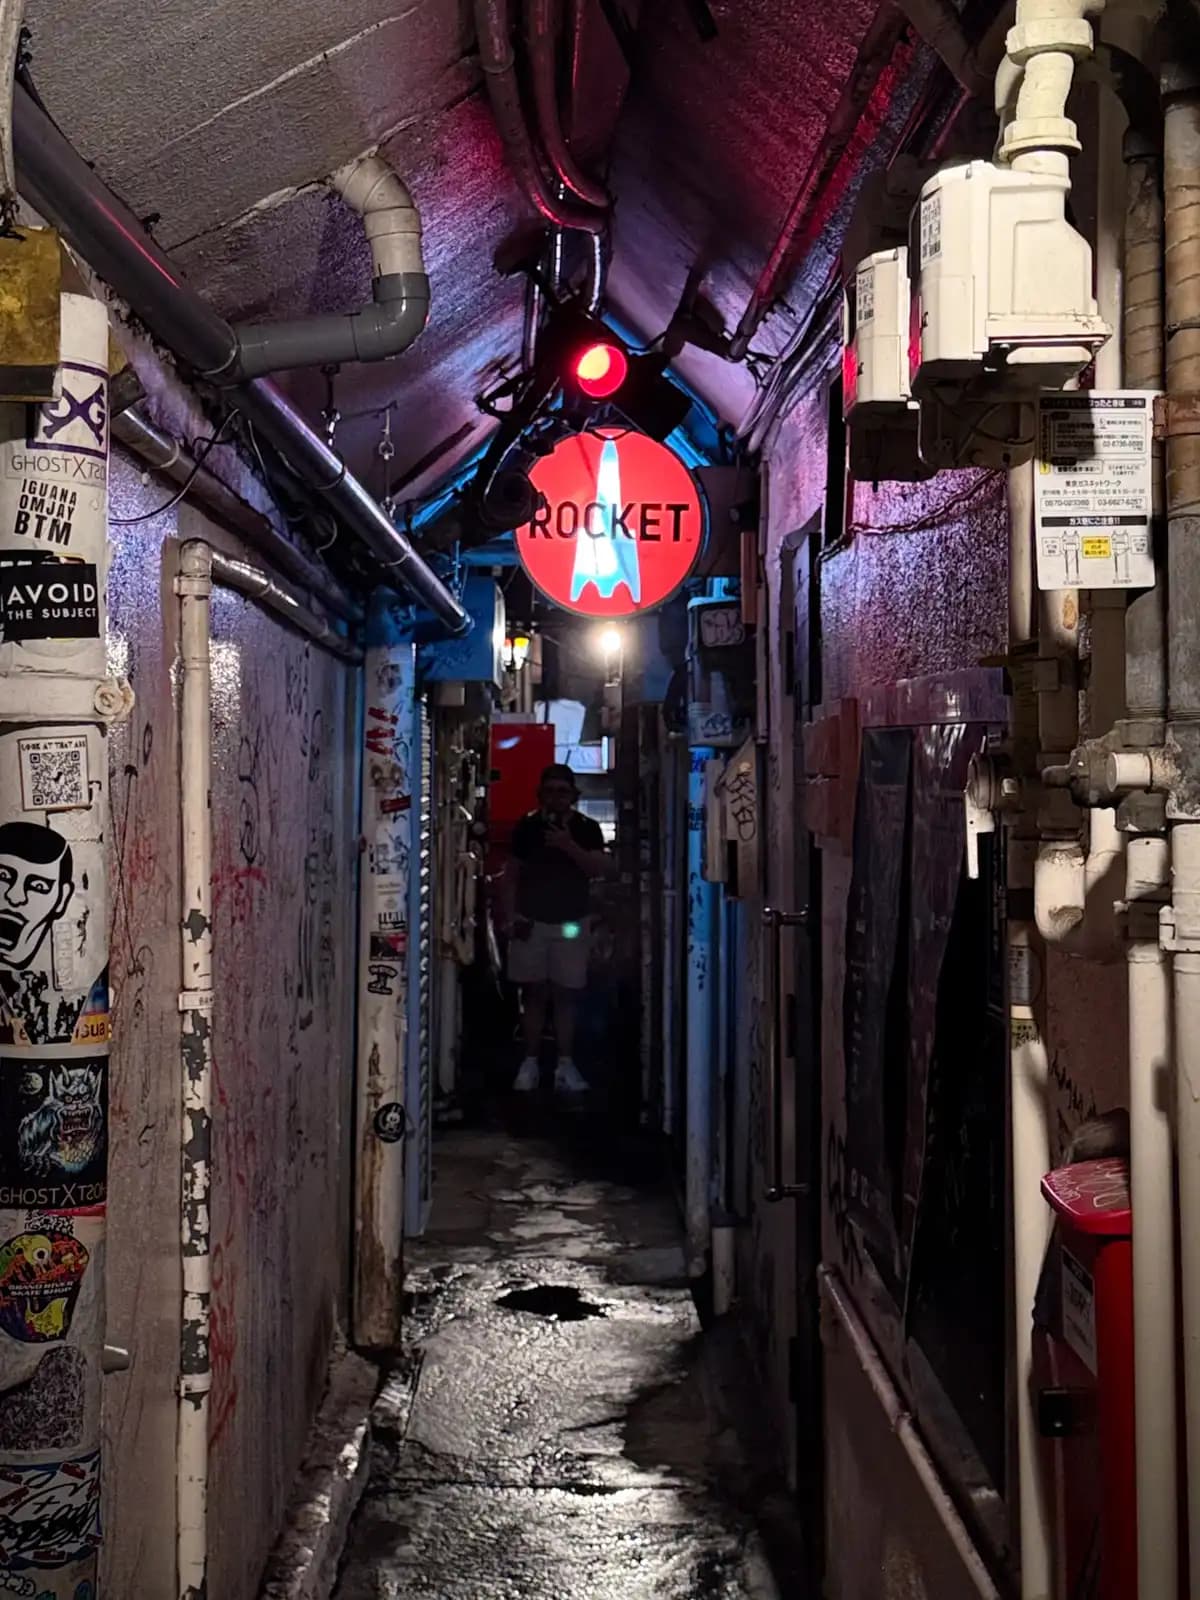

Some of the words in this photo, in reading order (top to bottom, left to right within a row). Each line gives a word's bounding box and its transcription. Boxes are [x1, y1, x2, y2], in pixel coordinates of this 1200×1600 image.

[21, 478, 77, 506] IGUANA
[19, 494, 75, 521] OMJAY
[14, 510, 72, 546] BTM
[528, 500, 690, 542] ROCKET
[7, 583, 96, 605] AVOID
[8, 609, 33, 620] THE
[42, 607, 96, 618] SUBJECT
[43, 742, 53, 750] AT
[54, 741, 73, 749] THAT
[10, 1289, 41, 1297] SKATE
[43, 1287, 73, 1295] SHOP
